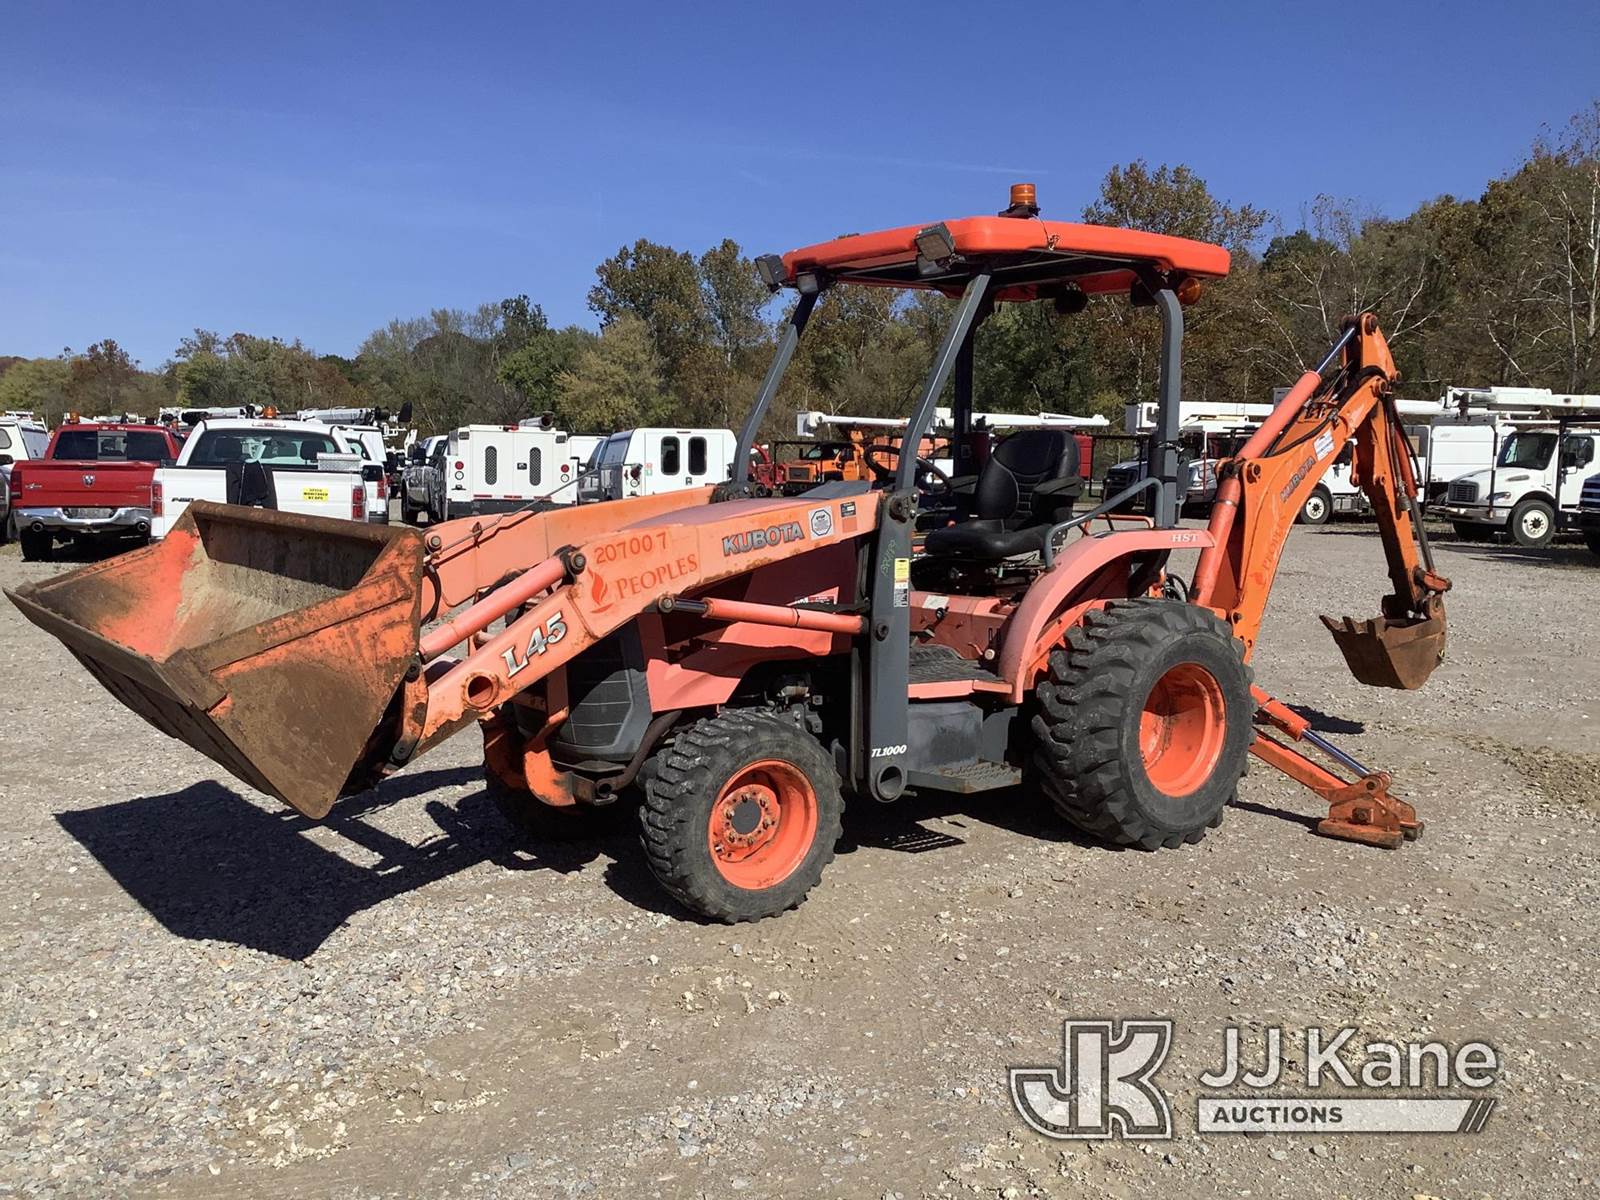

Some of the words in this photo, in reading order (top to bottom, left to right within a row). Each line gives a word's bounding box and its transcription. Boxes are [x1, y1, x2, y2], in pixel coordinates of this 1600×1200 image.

[722, 520, 805, 557] KUBOTA
[1172, 533, 1198, 542] HST
[616, 553, 698, 599] PEOPLES
[500, 610, 567, 678] L45
[871, 744, 907, 758] TL1000
